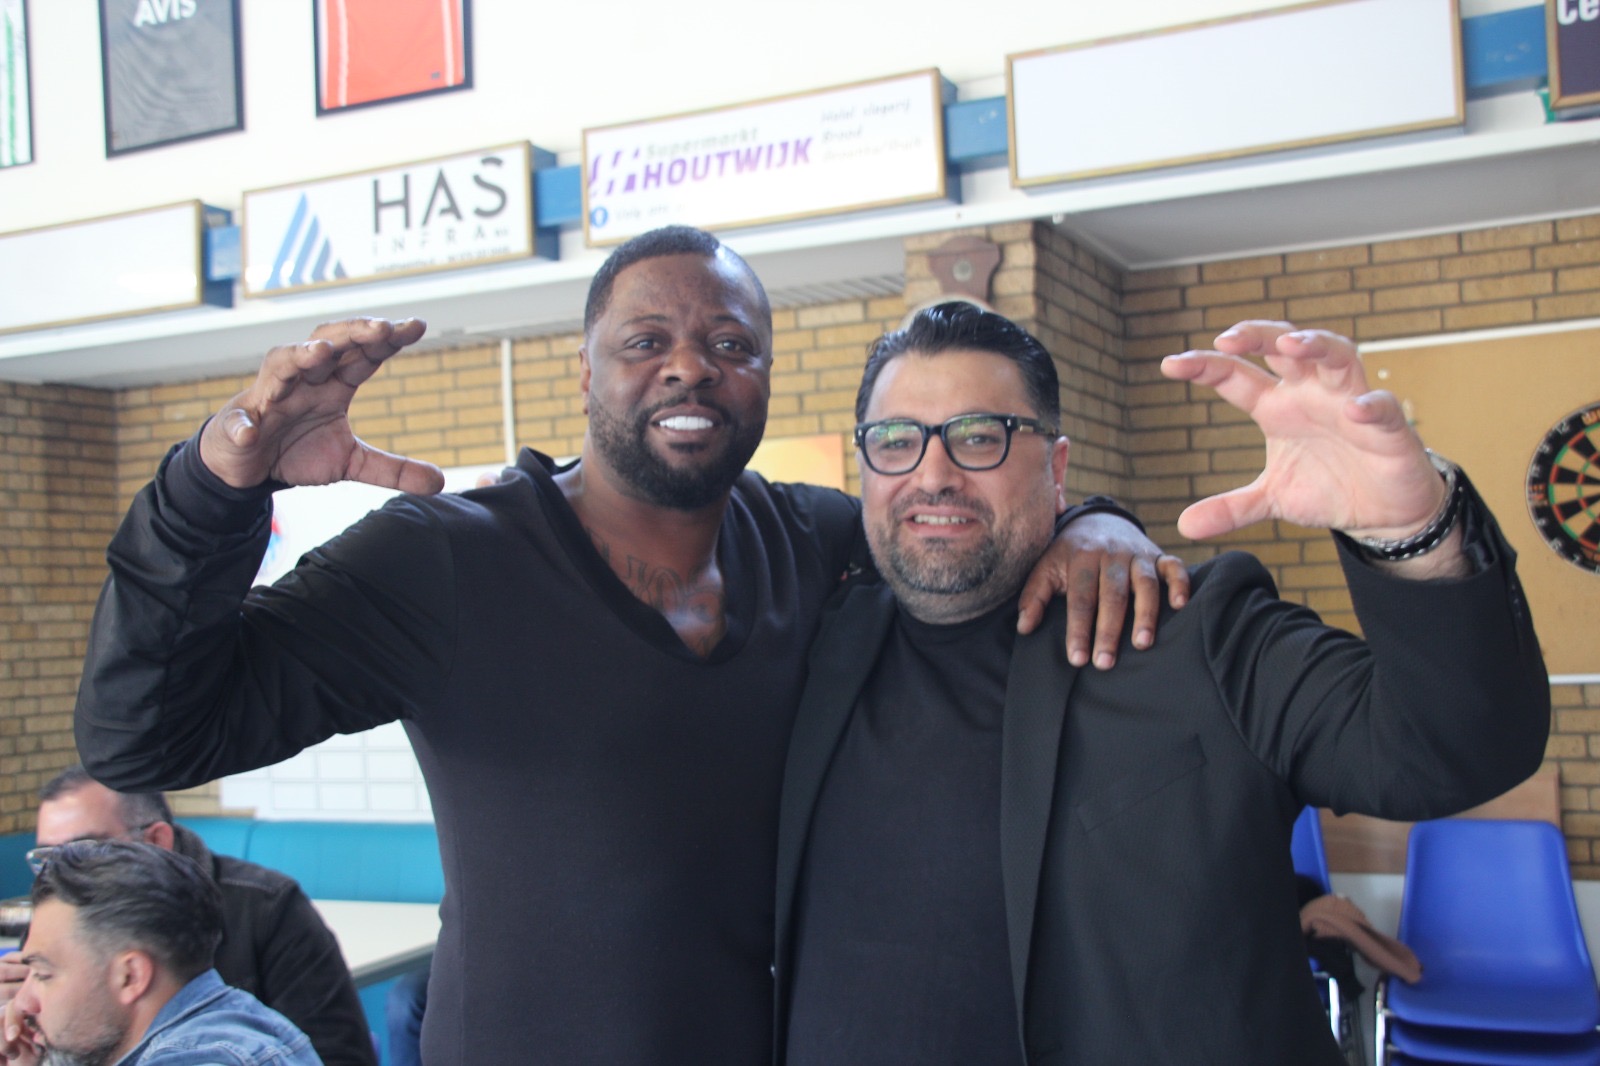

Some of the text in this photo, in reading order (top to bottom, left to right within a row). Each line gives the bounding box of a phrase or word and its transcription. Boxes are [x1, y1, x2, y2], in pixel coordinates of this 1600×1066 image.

[133, 0, 198, 27] AVIS
[645, 126, 759, 159] Supermarkt
[642, 136, 813, 190] HOUTWIJK
[372, 156, 508, 234] HAS
[373, 226, 485, 254] INFRA
